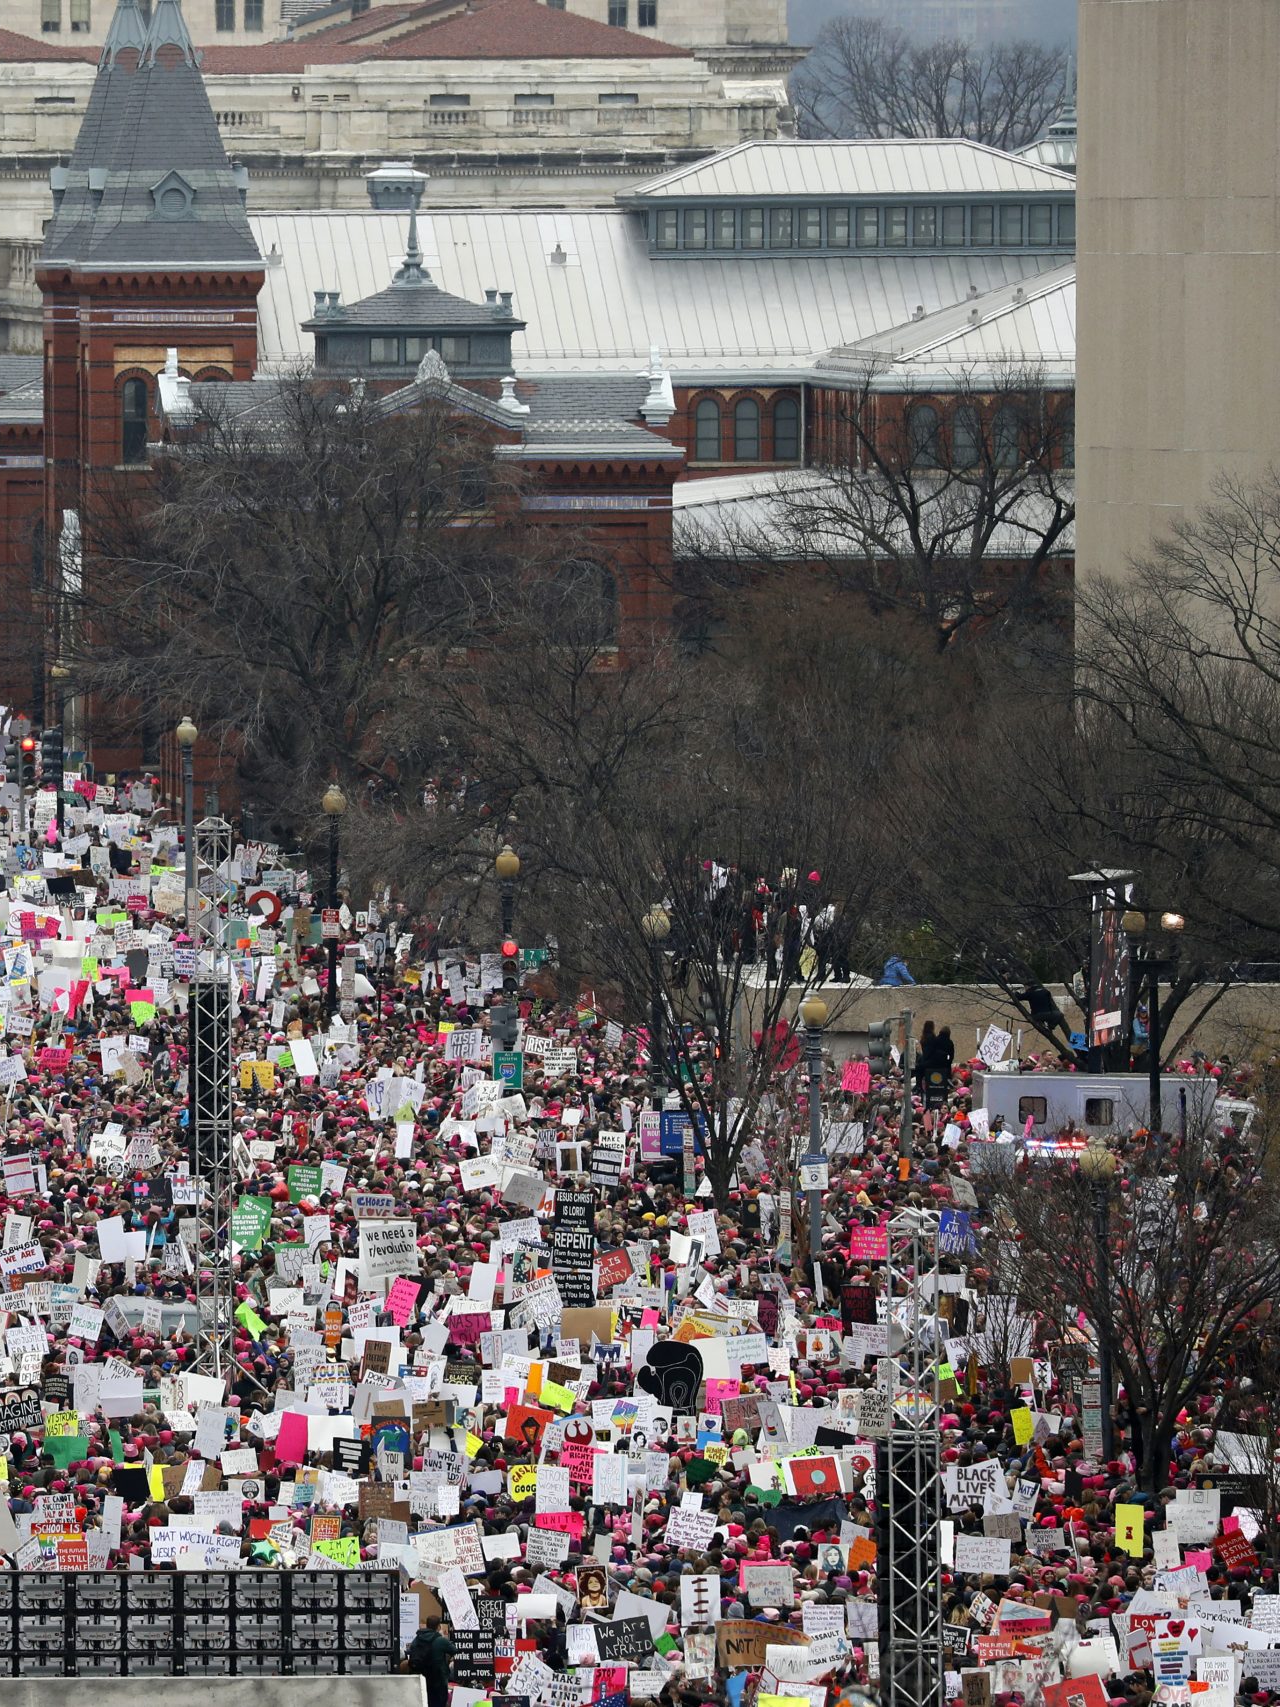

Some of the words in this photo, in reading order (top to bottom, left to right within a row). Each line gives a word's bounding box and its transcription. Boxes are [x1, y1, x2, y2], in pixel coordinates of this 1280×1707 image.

[452, 1032, 476, 1045] RISE
[526, 1036, 553, 1053] RISE!
[357, 1197, 392, 1206] CHOOSE
[557, 1192, 572, 1203] JESUS
[574, 1193, 593, 1204] CHRIST
[359, 1207, 390, 1216] LOVE
[563, 1206, 568, 1215] IS
[569, 1206, 585, 1216] LORD!
[366, 1232, 379, 1241] we
[383, 1230, 405, 1240] need
[555, 1234, 592, 1249] REPENT
[4, 1256, 16, 1264] WE
[21, 1249, 35, 1258] ARE
[4, 1301, 26, 1310] UPSET!
[350, 1304, 370, 1314] HEAR
[352, 1314, 368, 1322] OUR
[448, 1314, 488, 1328] NASTY
[25, 1352, 41, 1361] CTRL
[21, 1372, 40, 1380] DELETE
[55, 1411, 77, 1422] STRONG
[858, 1420, 884, 1428] TRUMP
[385, 1453, 399, 1464] YOU
[437, 1452, 456, 1462] WHO
[570, 1452, 593, 1460] RIGHTS
[424, 1459, 442, 1469] RUNS
[446, 1462, 462, 1473] THE
[562, 1463, 590, 1474] HUMAN
[540, 1469, 568, 1481] STRONG
[957, 1468, 996, 1482] BLACK
[540, 1482, 564, 1490] WOMEN
[957, 1482, 995, 1494] LIVES
[543, 1515, 576, 1524] UNITE
[34, 1524, 66, 1533] SCHOOL
[70, 1524, 80, 1533] IS
[154, 1532, 176, 1541] WHAT
[189, 1534, 213, 1545] CIVIL
[216, 1536, 240, 1548] RIGHTS
[329, 1541, 342, 1549] I'M
[1229, 1542, 1249, 1555] STILL
[152, 1547, 176, 1558] JESUS
[454, 1548, 478, 1557] CHANGE
[1225, 1551, 1254, 1565] FEMALE
[360, 1560, 379, 1570] WHO
[381, 1558, 397, 1568] RUN
[482, 1619, 492, 1627] OR
[572, 1625, 591, 1642] THIS
[598, 1627, 615, 1639] We
[622, 1621, 645, 1634] Are
[617, 1634, 634, 1646] NOT
[494, 1646, 514, 1657] NOT
[606, 1639, 652, 1657] AFRAID
[725, 1639, 753, 1654] NOT
[1033, 1661, 1050, 1670] MY
[552, 1673, 582, 1685] MAKE
[596, 1669, 616, 1678] STOP
[1026, 1672, 1055, 1683] BODY
[551, 1691, 578, 1701] KIND
